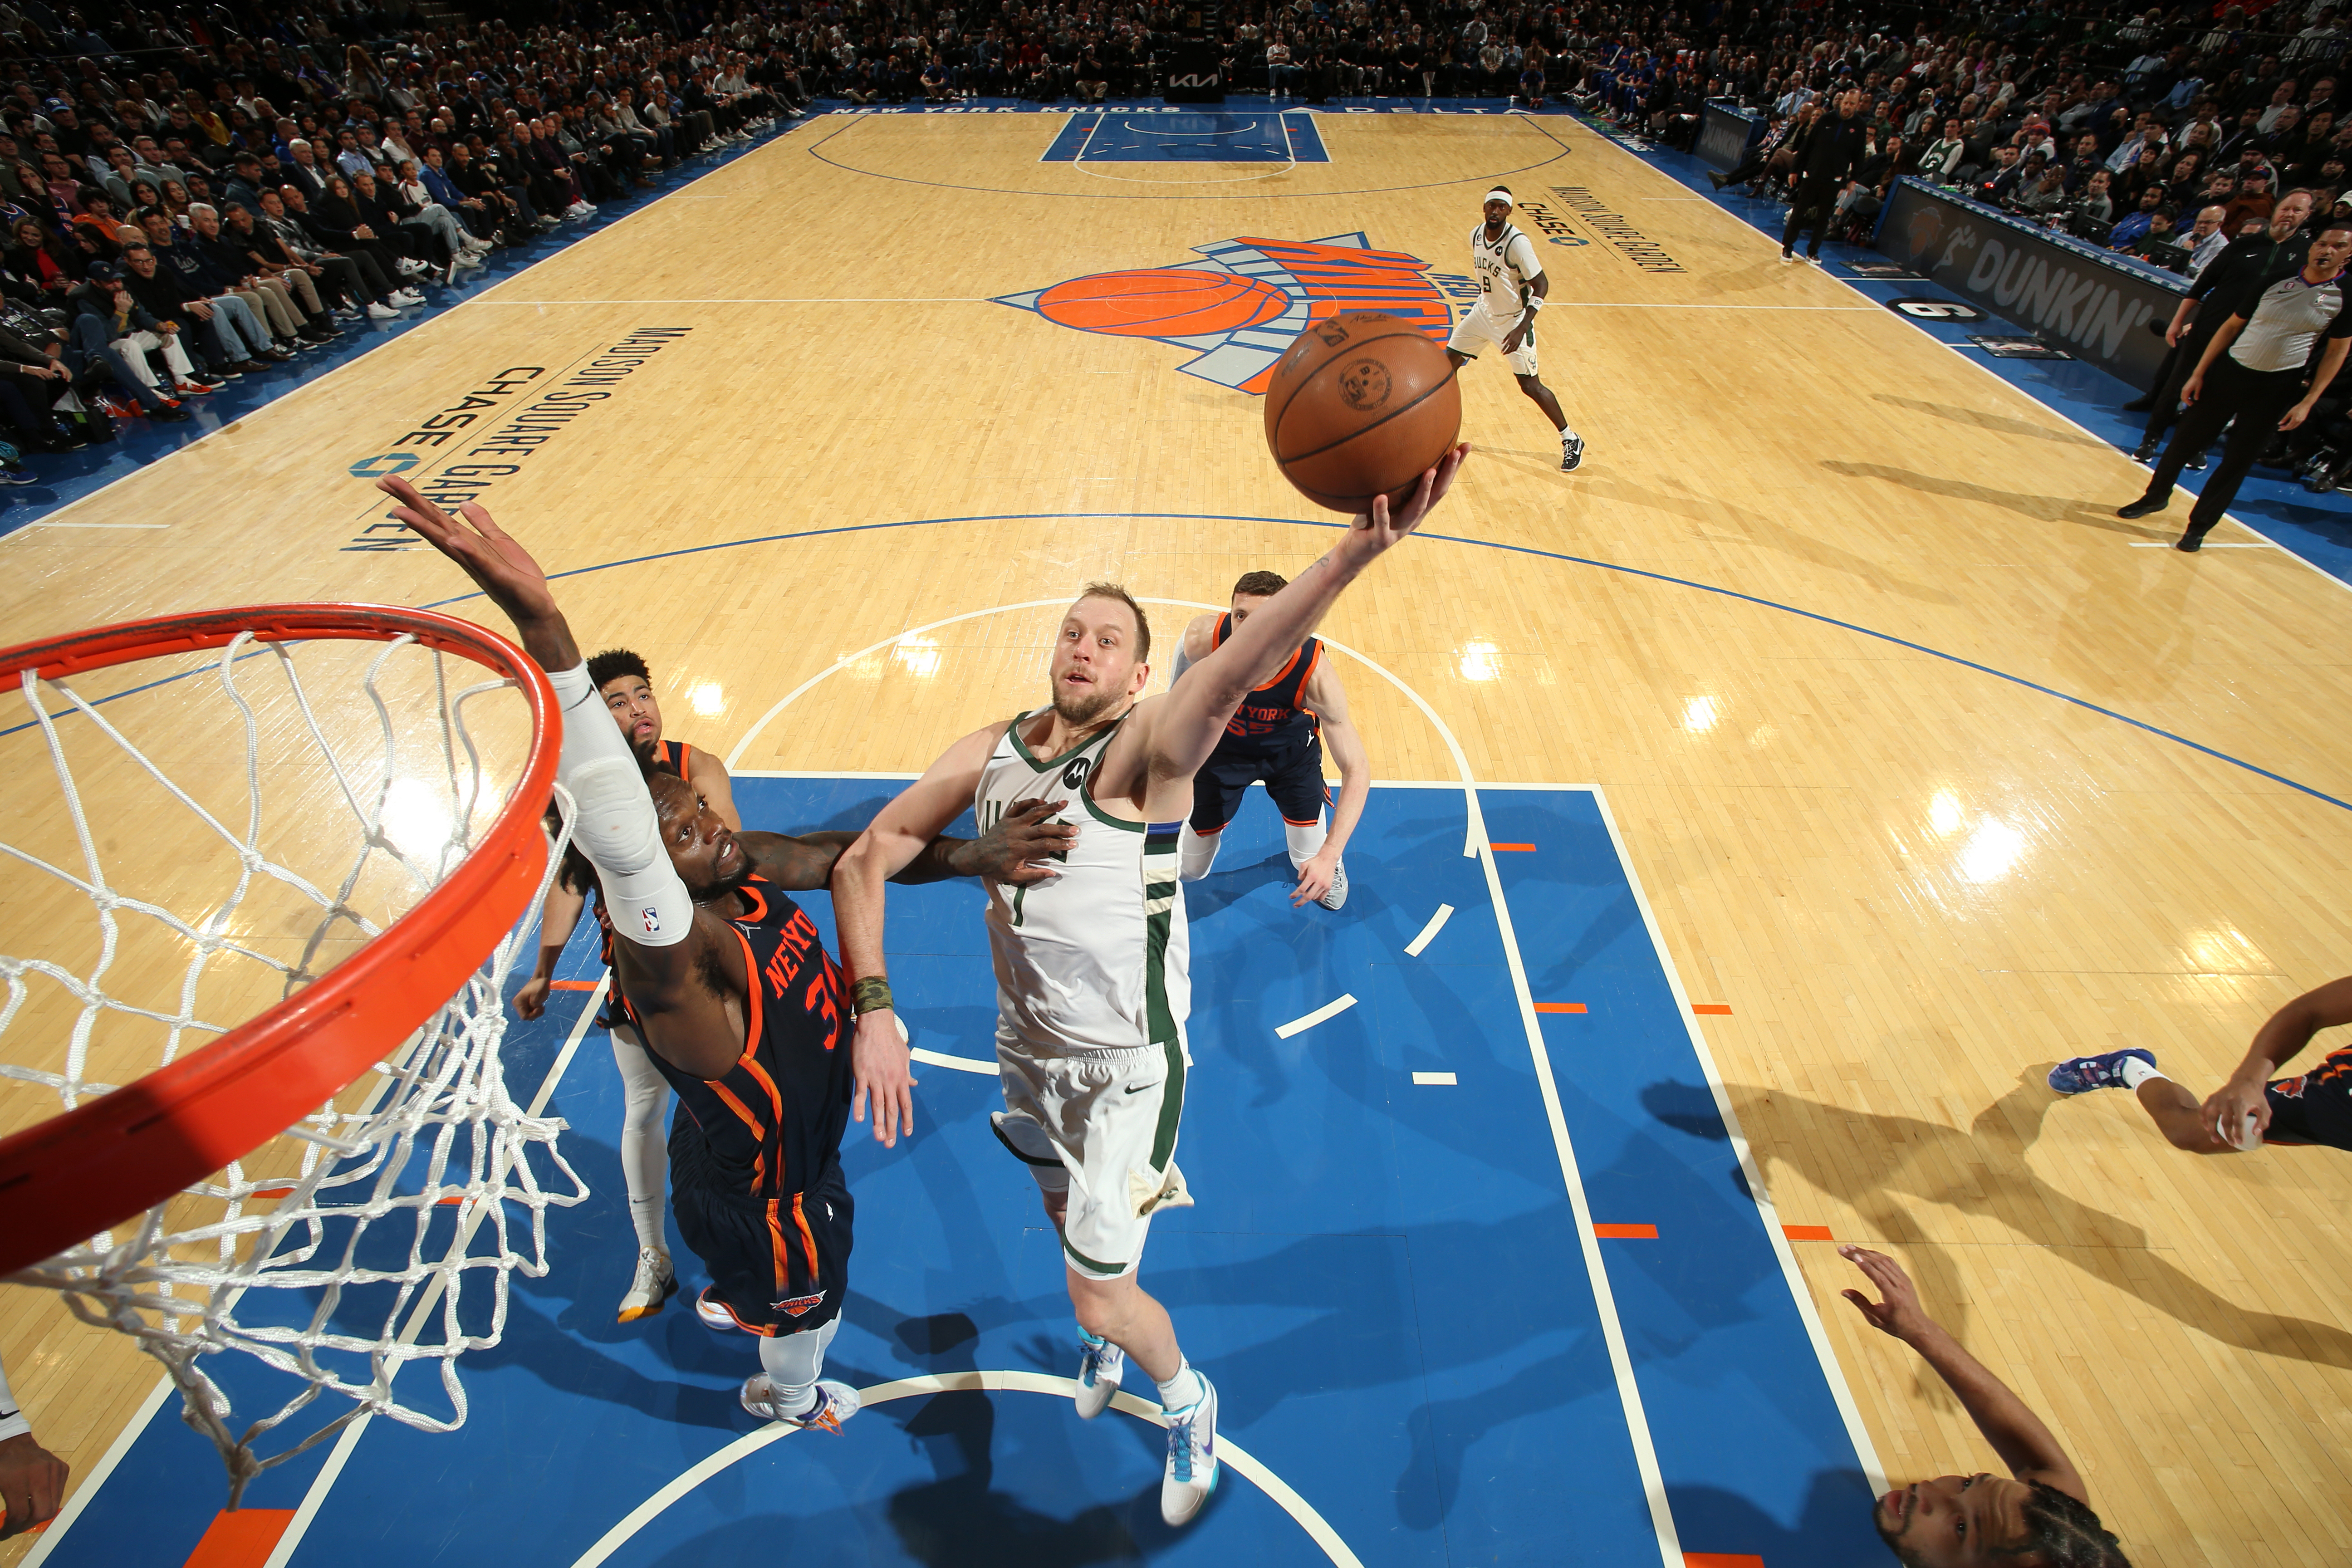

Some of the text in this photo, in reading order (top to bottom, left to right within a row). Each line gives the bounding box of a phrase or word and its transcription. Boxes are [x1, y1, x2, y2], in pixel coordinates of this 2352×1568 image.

[1169, 74, 1218, 87] KIA
[1518, 203, 1576, 235] CHASE
[1548, 187, 1688, 273] MADISON SQUARE GARDEN
[1474, 256, 1501, 278] BUCKS
[1482, 276, 1492, 293] 9
[391, 367, 546, 447] CHASE
[339, 327, 695, 552] MADISON SQUARE GAREN
[1247, 706, 1291, 721] YORK
[775, 1295, 821, 1309] KNICKS
